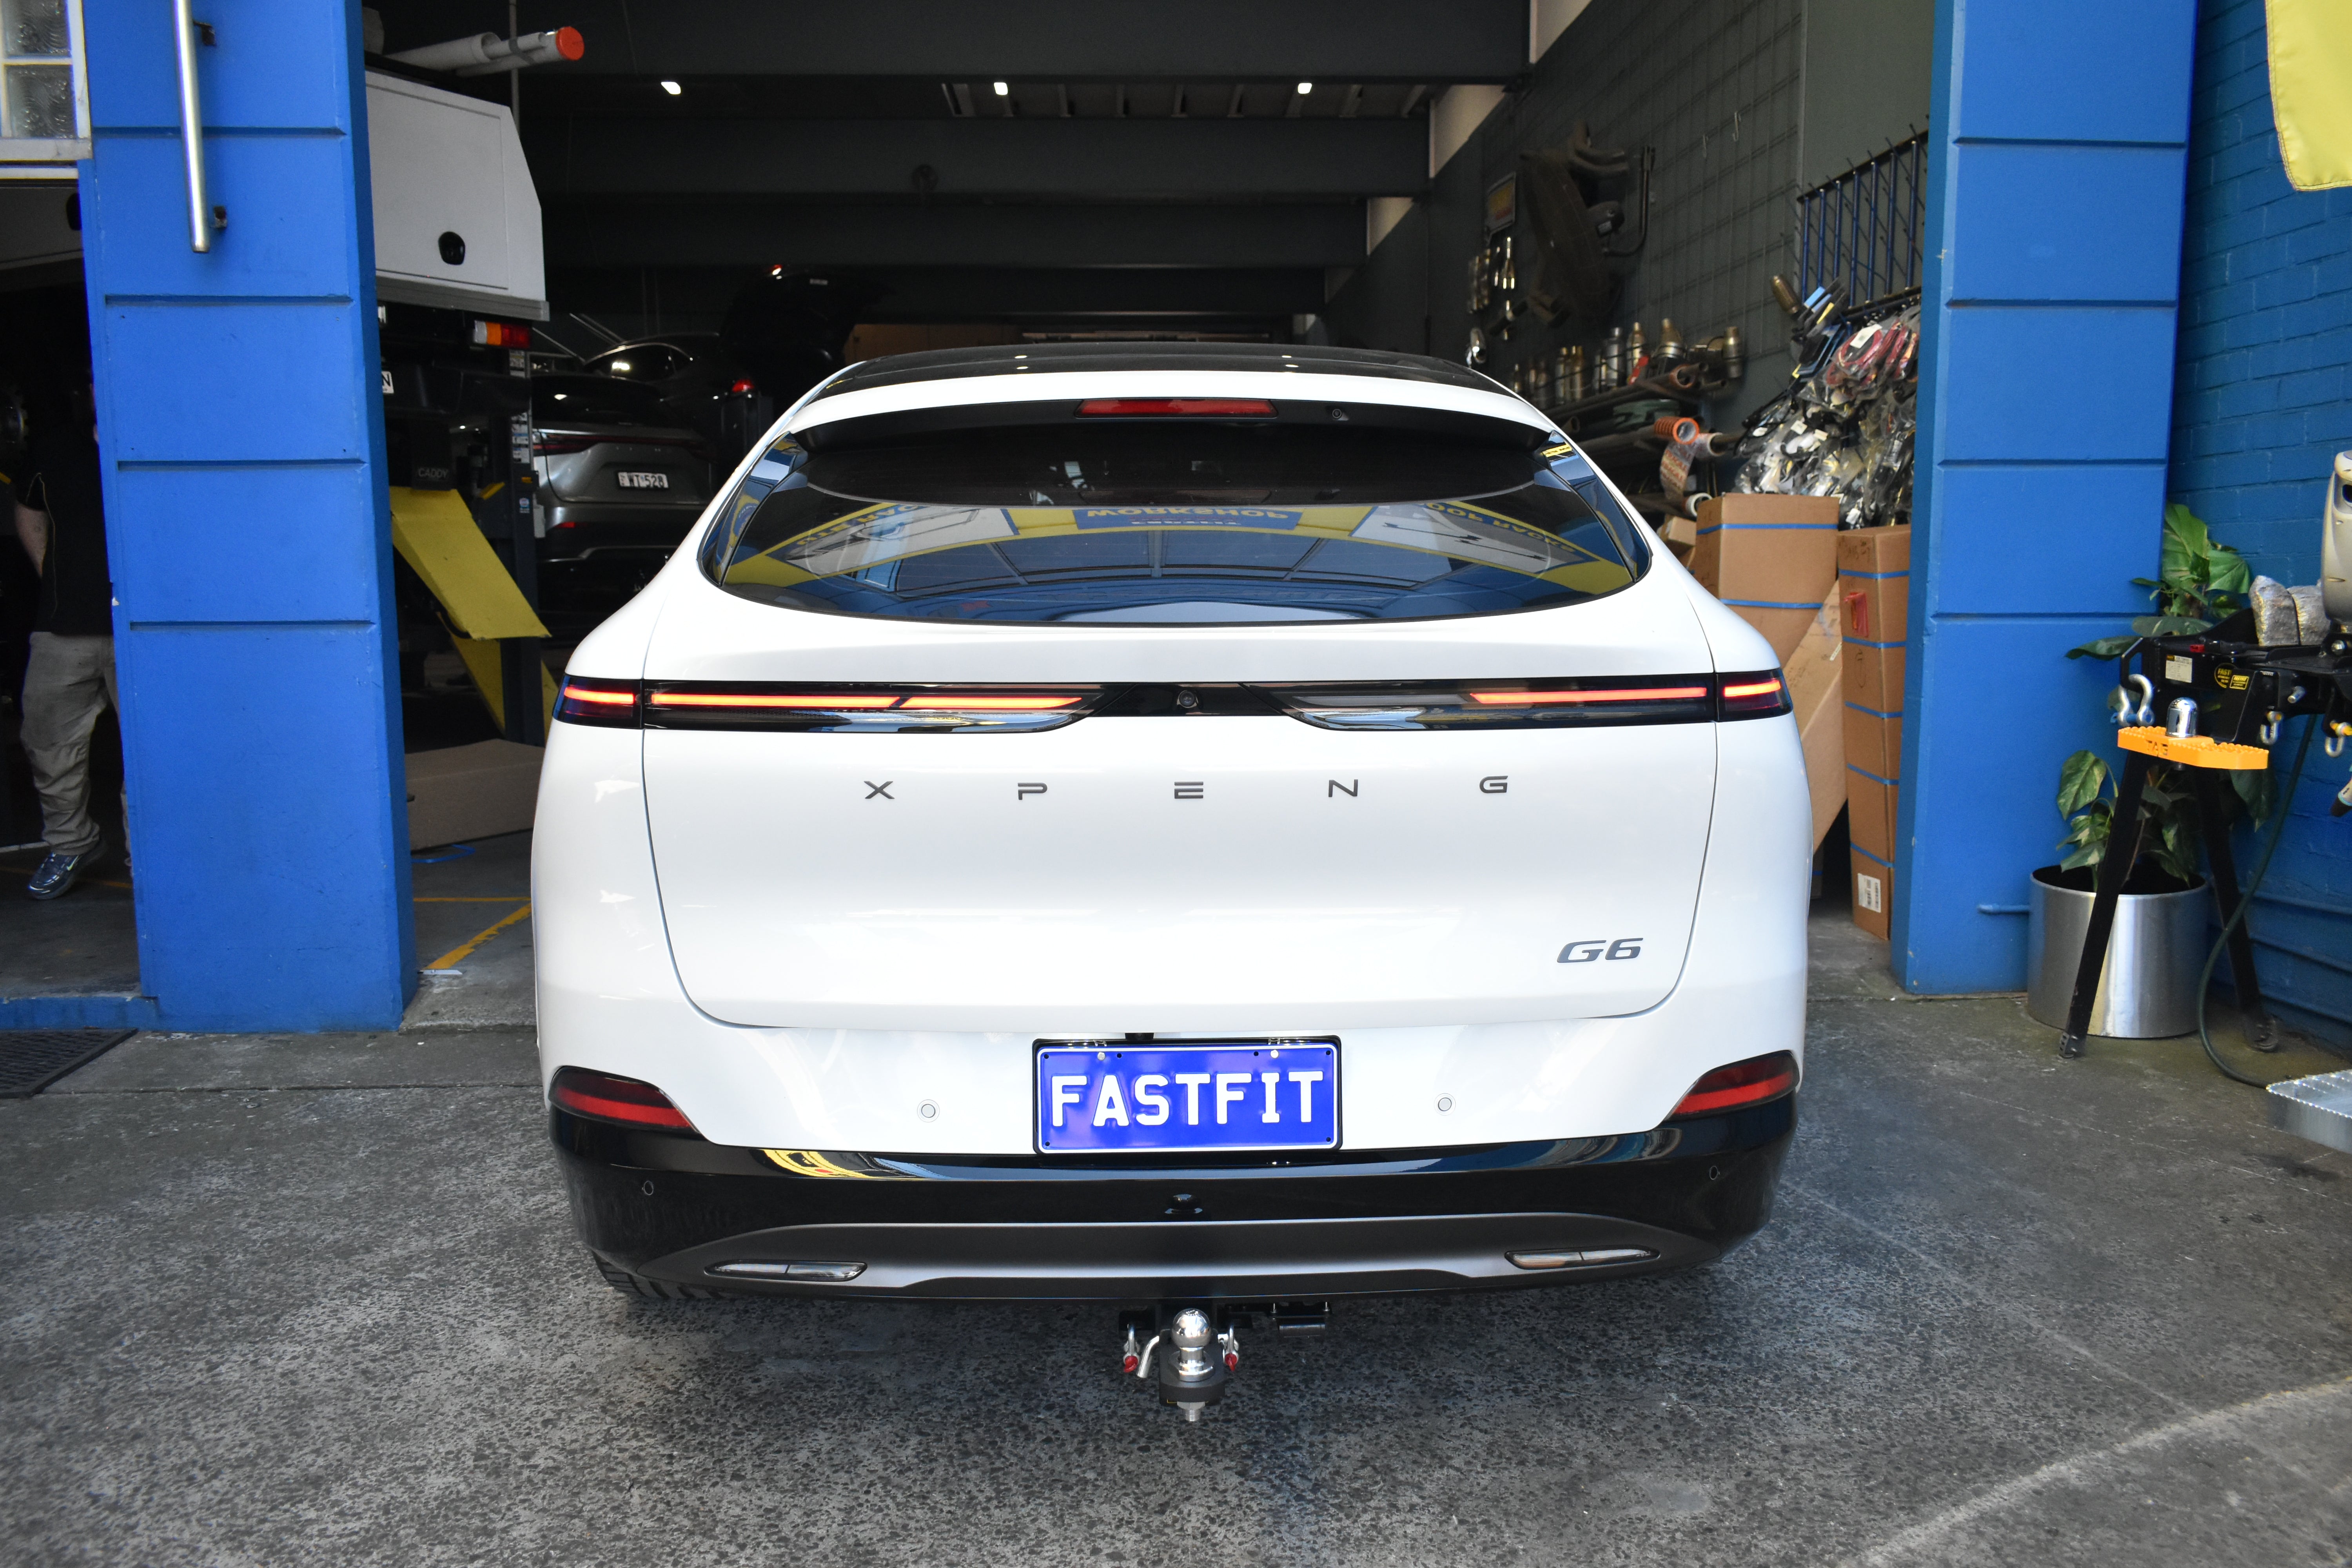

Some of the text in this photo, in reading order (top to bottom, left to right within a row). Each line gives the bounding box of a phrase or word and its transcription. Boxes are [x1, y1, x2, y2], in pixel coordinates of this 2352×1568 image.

[418, 468, 449, 478] CADDY
[864, 776, 1508, 800] XPENG
[1557, 938, 1643, 963] G6
[1051, 1070, 1324, 1127] FASTFIT
